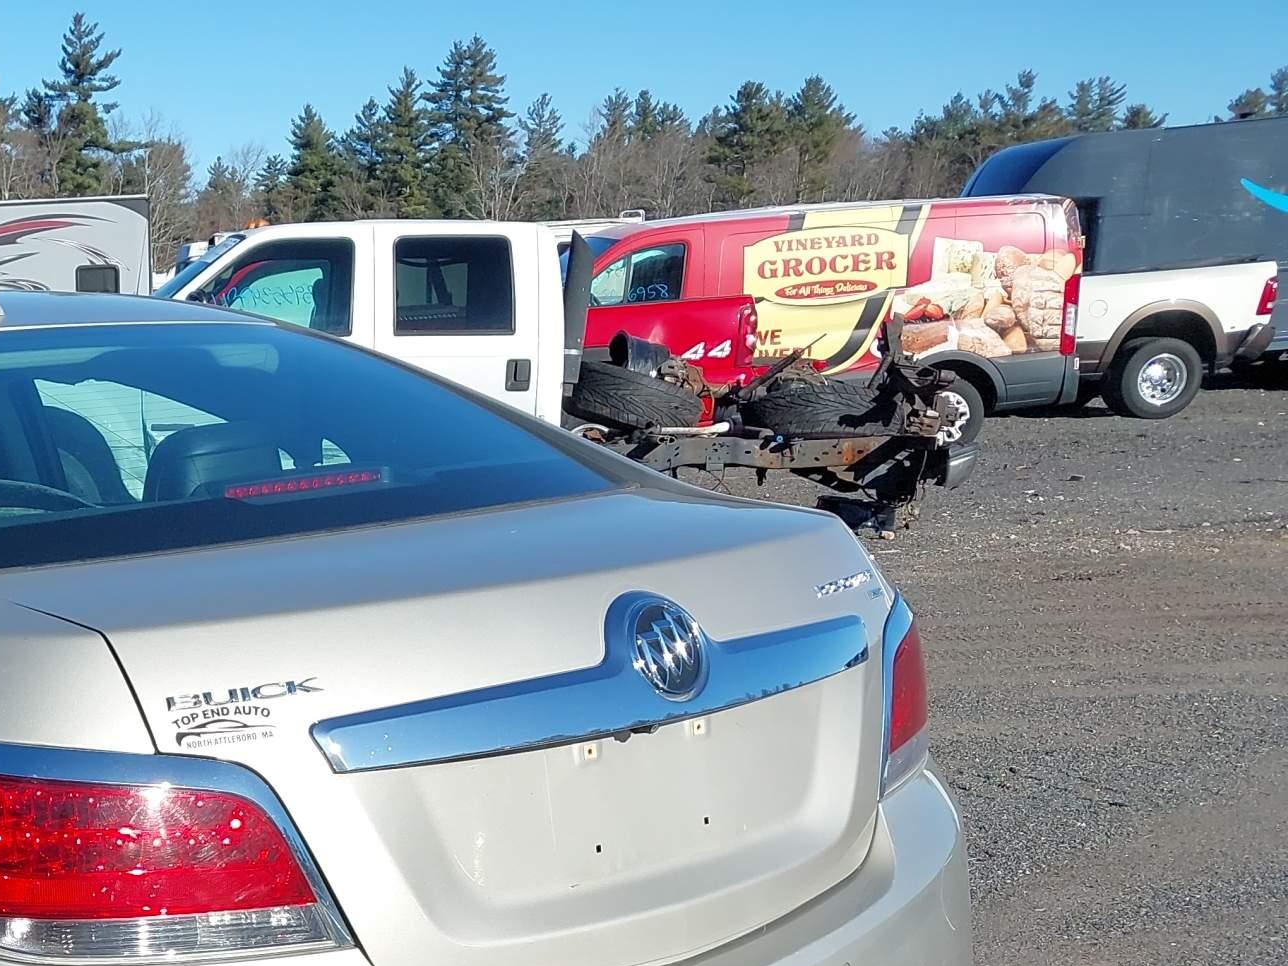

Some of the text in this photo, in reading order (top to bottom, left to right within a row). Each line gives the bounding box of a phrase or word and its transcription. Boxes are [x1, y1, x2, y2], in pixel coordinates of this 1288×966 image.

[773, 233, 880, 252] VINEYARD
[758, 251, 897, 279] GROCER
[627, 283, 669, 302] 6958
[784, 281, 868, 297] For All Things Delicious
[166, 677, 325, 711] BUICK
[171, 705, 271, 730] TOP END AUTO
[186, 730, 275, 749] NORTH ATTLEBORO MA
